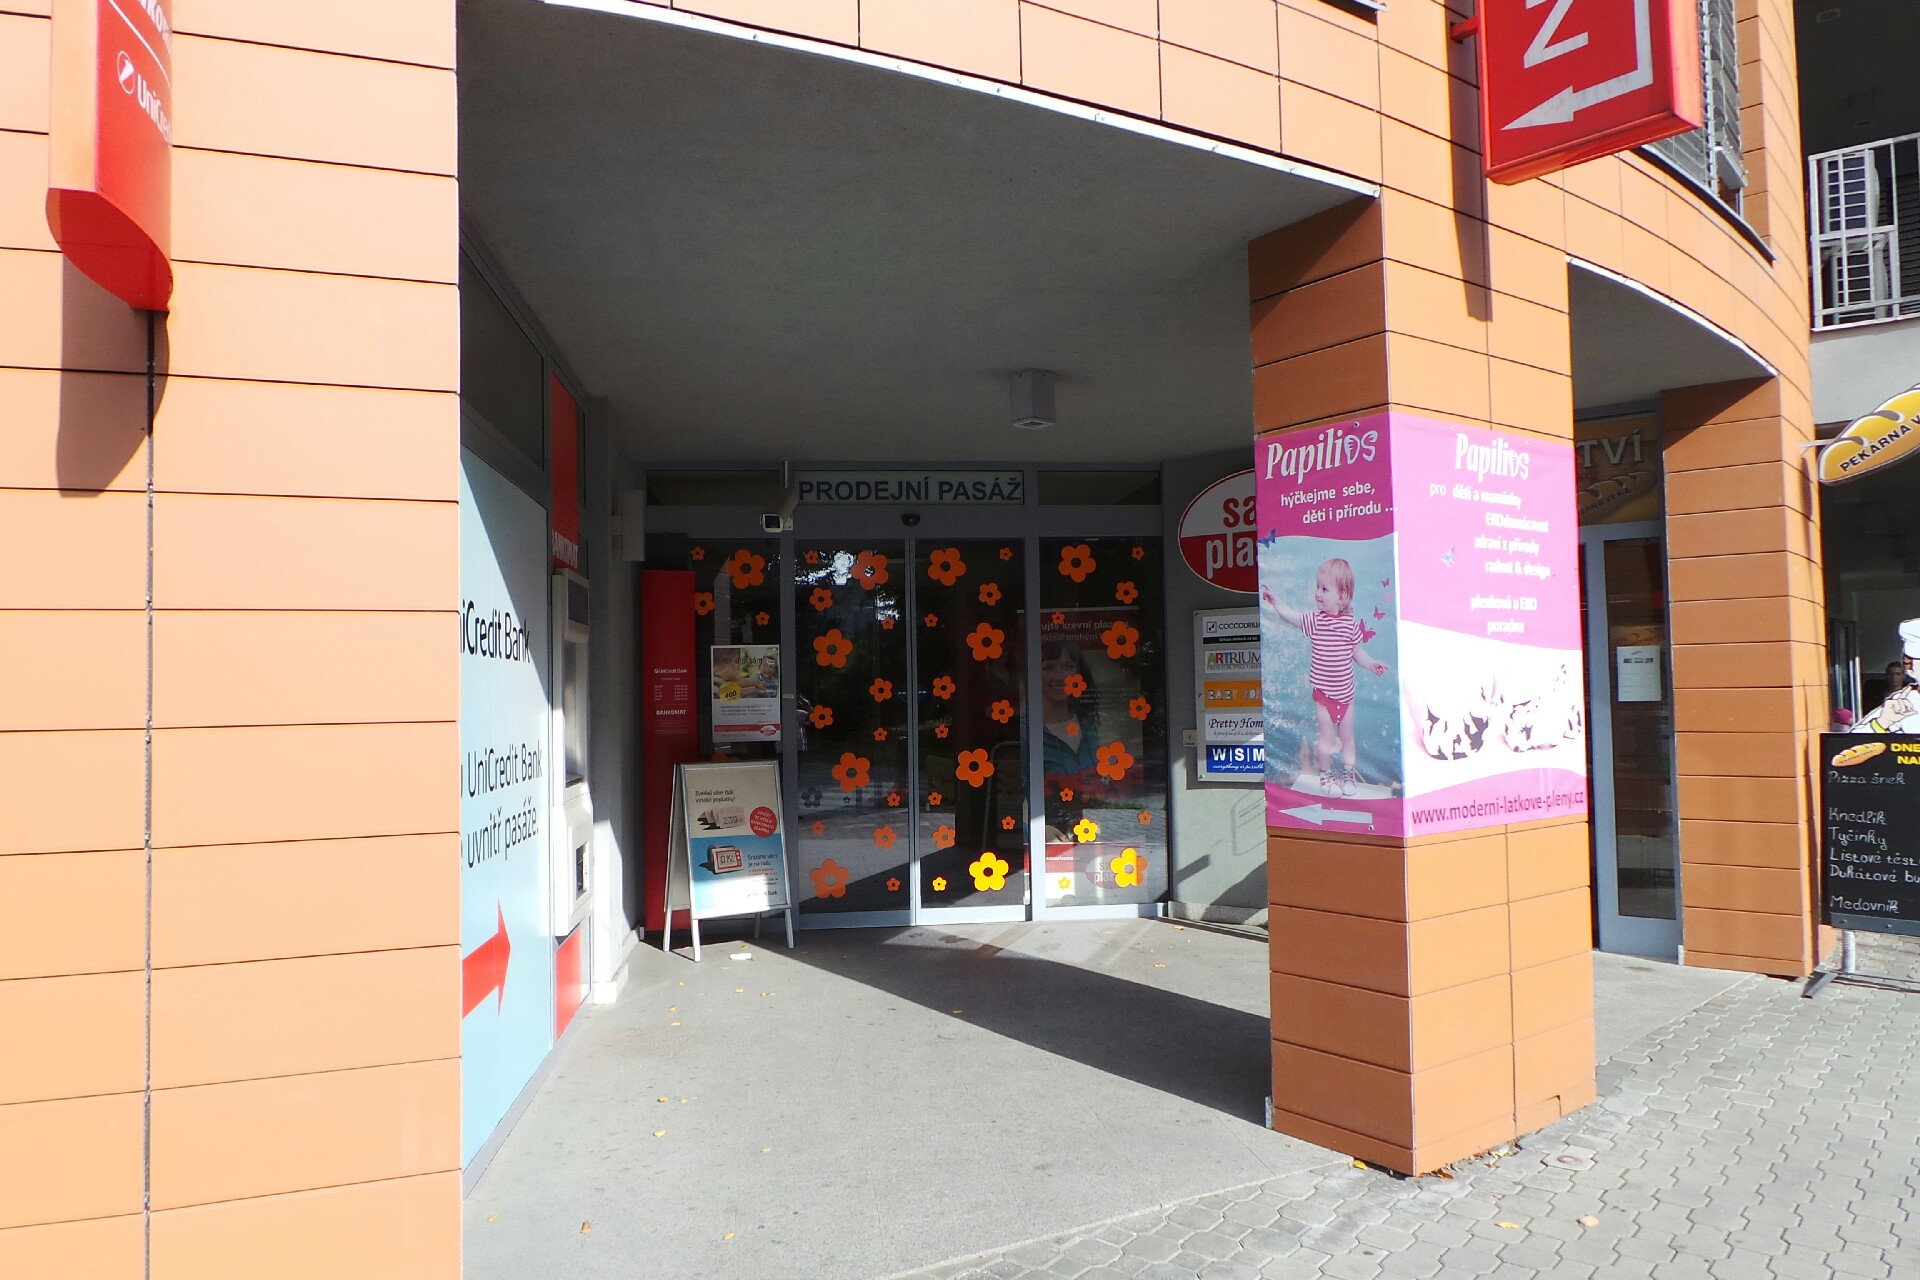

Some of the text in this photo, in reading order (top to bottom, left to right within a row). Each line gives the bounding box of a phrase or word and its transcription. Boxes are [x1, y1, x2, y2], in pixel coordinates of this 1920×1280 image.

[1265, 428, 1378, 485] Papilios
[1454, 432, 1530, 484] Papilios
[1840, 424, 1911, 473] PEKARNA
[799, 476, 1021, 501] PRODEJNÍ PASÁŽ
[1281, 481, 1375, 508] hýčkejme sebe,
[1430, 483, 1447, 498] pro
[1473, 489, 1480, 501] a
[1302, 508, 1326, 524] děti
[1329, 507, 1333, 520] i
[1336, 501, 1381, 522] přírodu
[1205, 532, 1255, 580] pla
[504, 611, 530, 663] Bank
[1042, 621, 1060, 631] ujte
[1218, 621, 1260, 630] COCCODRILL
[724, 690, 737, 699] 400
[1209, 717, 1263, 731] Pretty Hom
[468, 743, 519, 798] UniCredit
[521, 740, 543, 782] Bank
[1828, 770, 1867, 783] Pizza
[1412, 790, 1584, 825] www.moderni-latkove-pleny.cz
[468, 806, 502, 868] uvnitř
[505, 796, 539, 861] pasáže.
[1827, 826, 1888, 850] Tyčinky
[1886, 852, 1920, 866] těst
